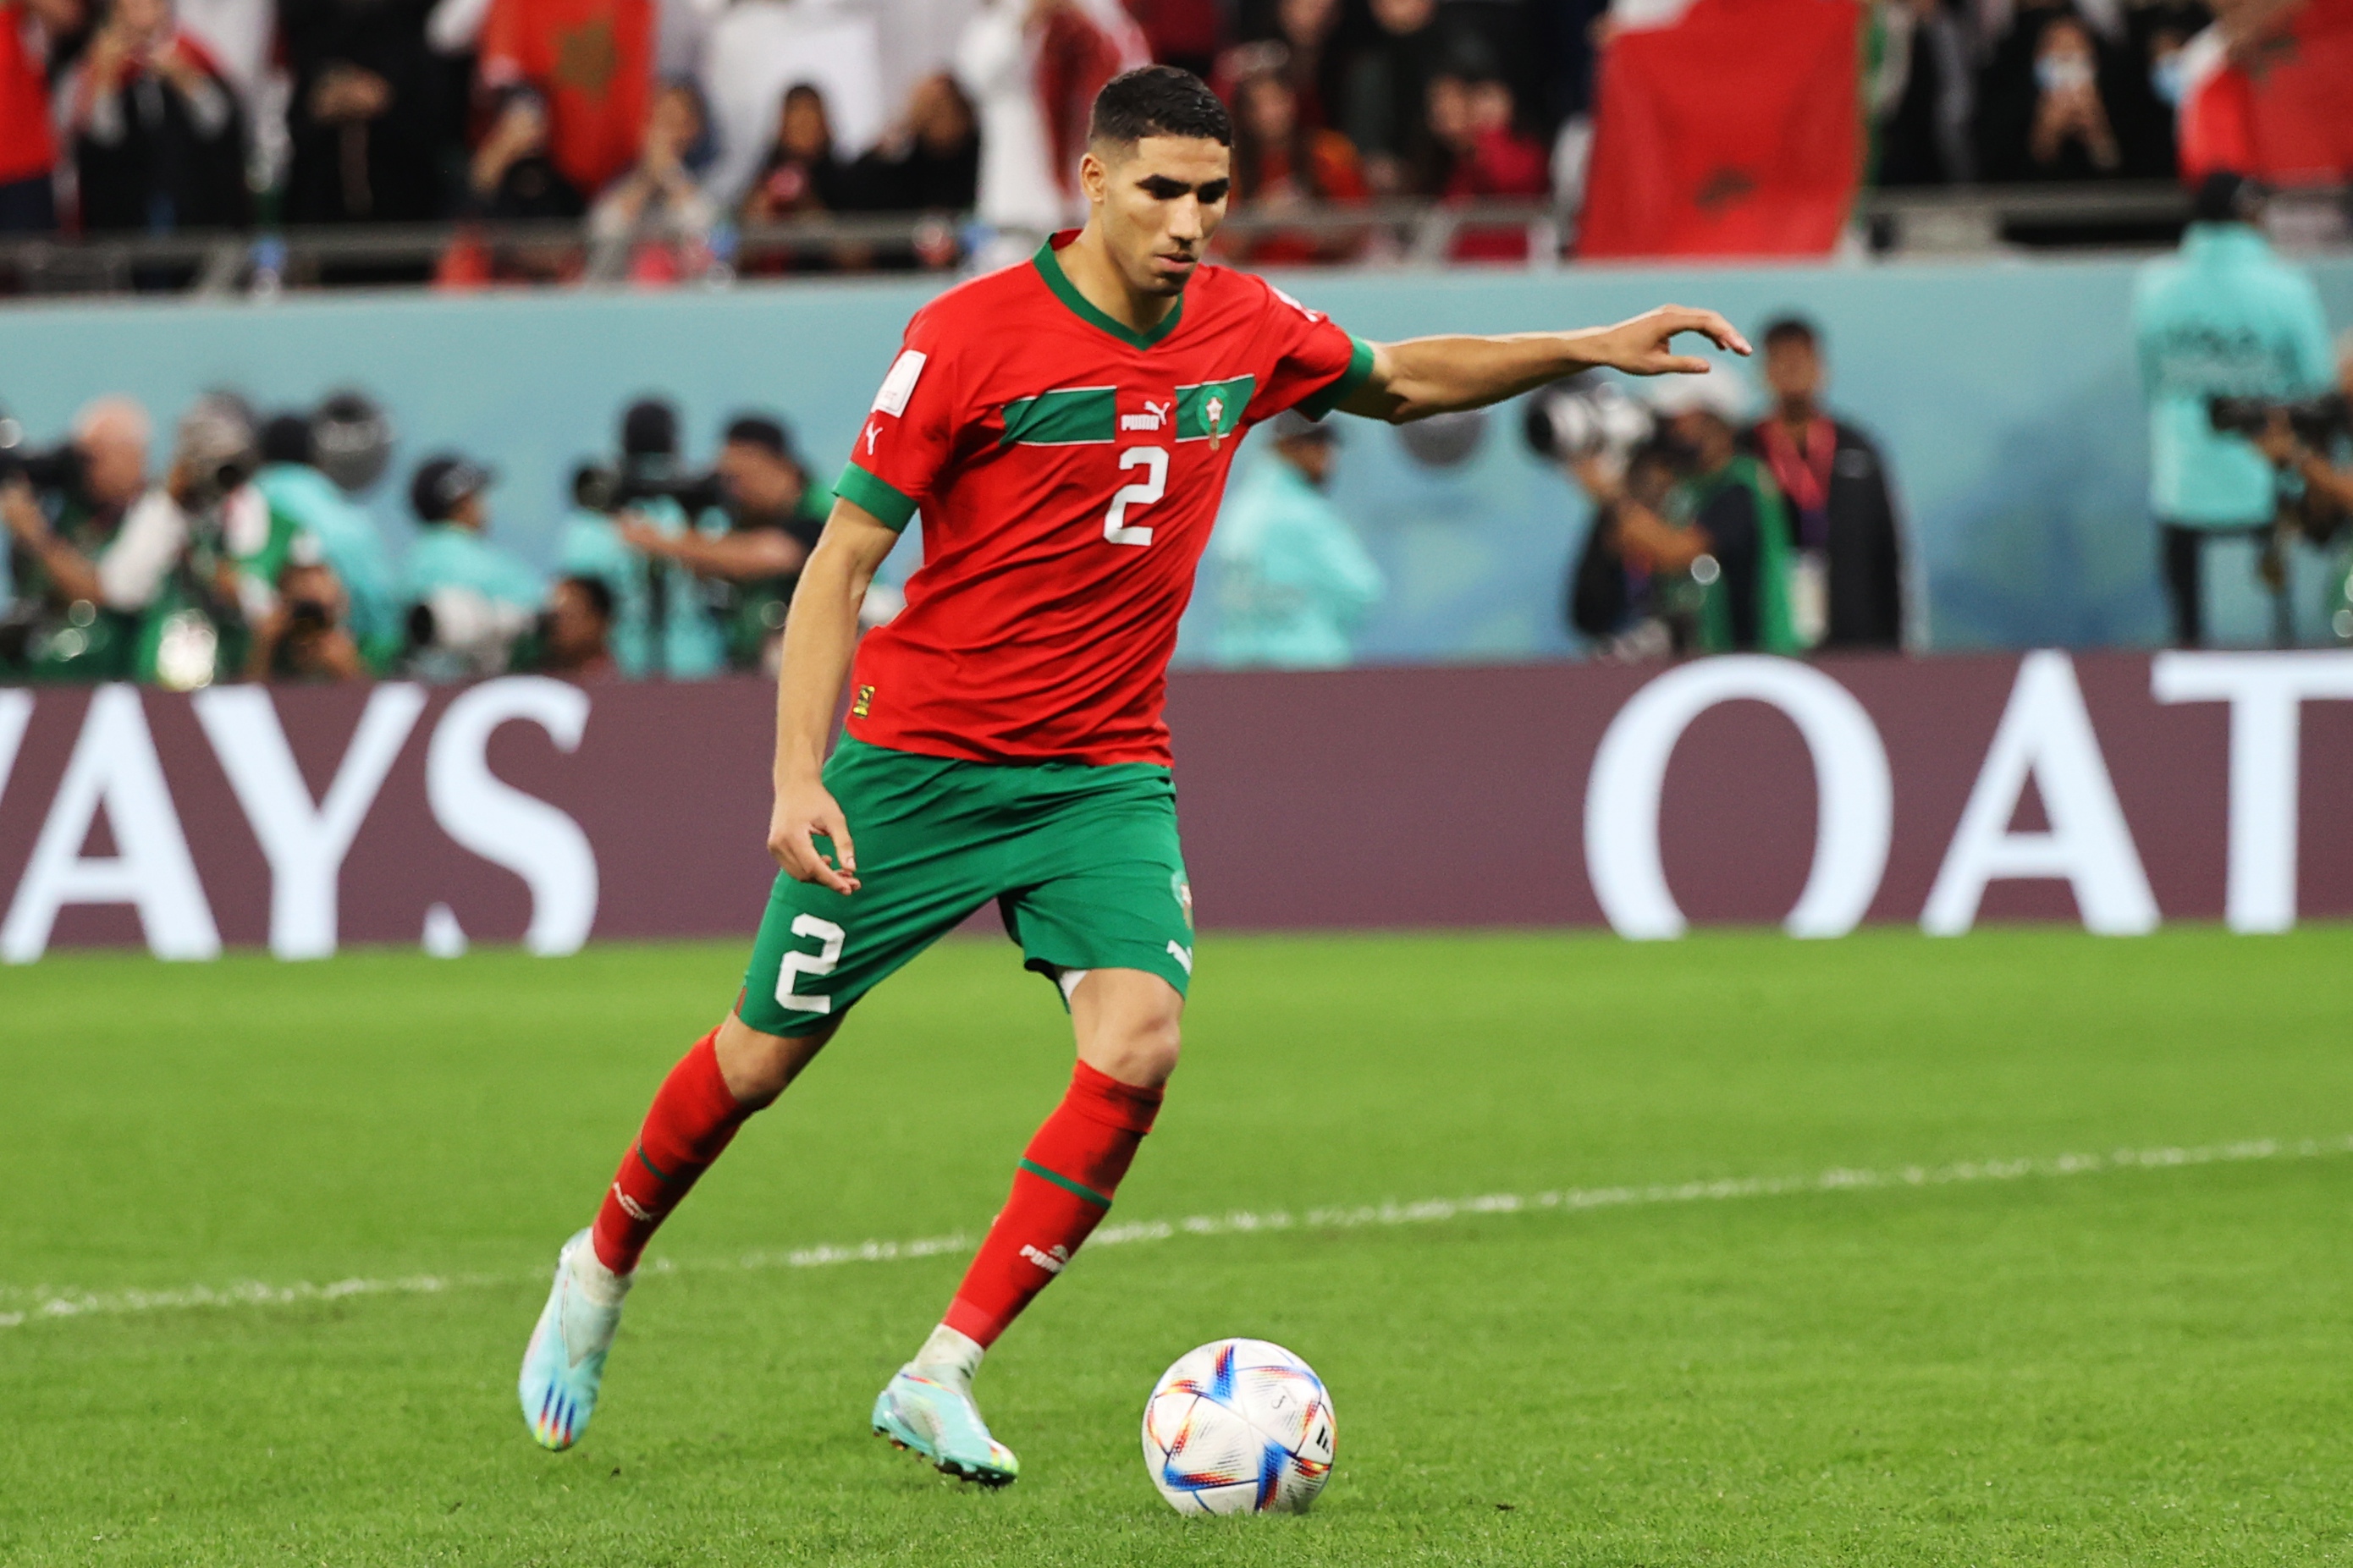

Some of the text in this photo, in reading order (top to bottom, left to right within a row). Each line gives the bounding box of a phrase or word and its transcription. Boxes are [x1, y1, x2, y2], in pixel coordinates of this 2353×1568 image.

[1121, 415, 1160, 431] PUMA
[1104, 446, 1169, 546] 2
[0, 675, 598, 963] AYS
[774, 912, 846, 1014] 2
